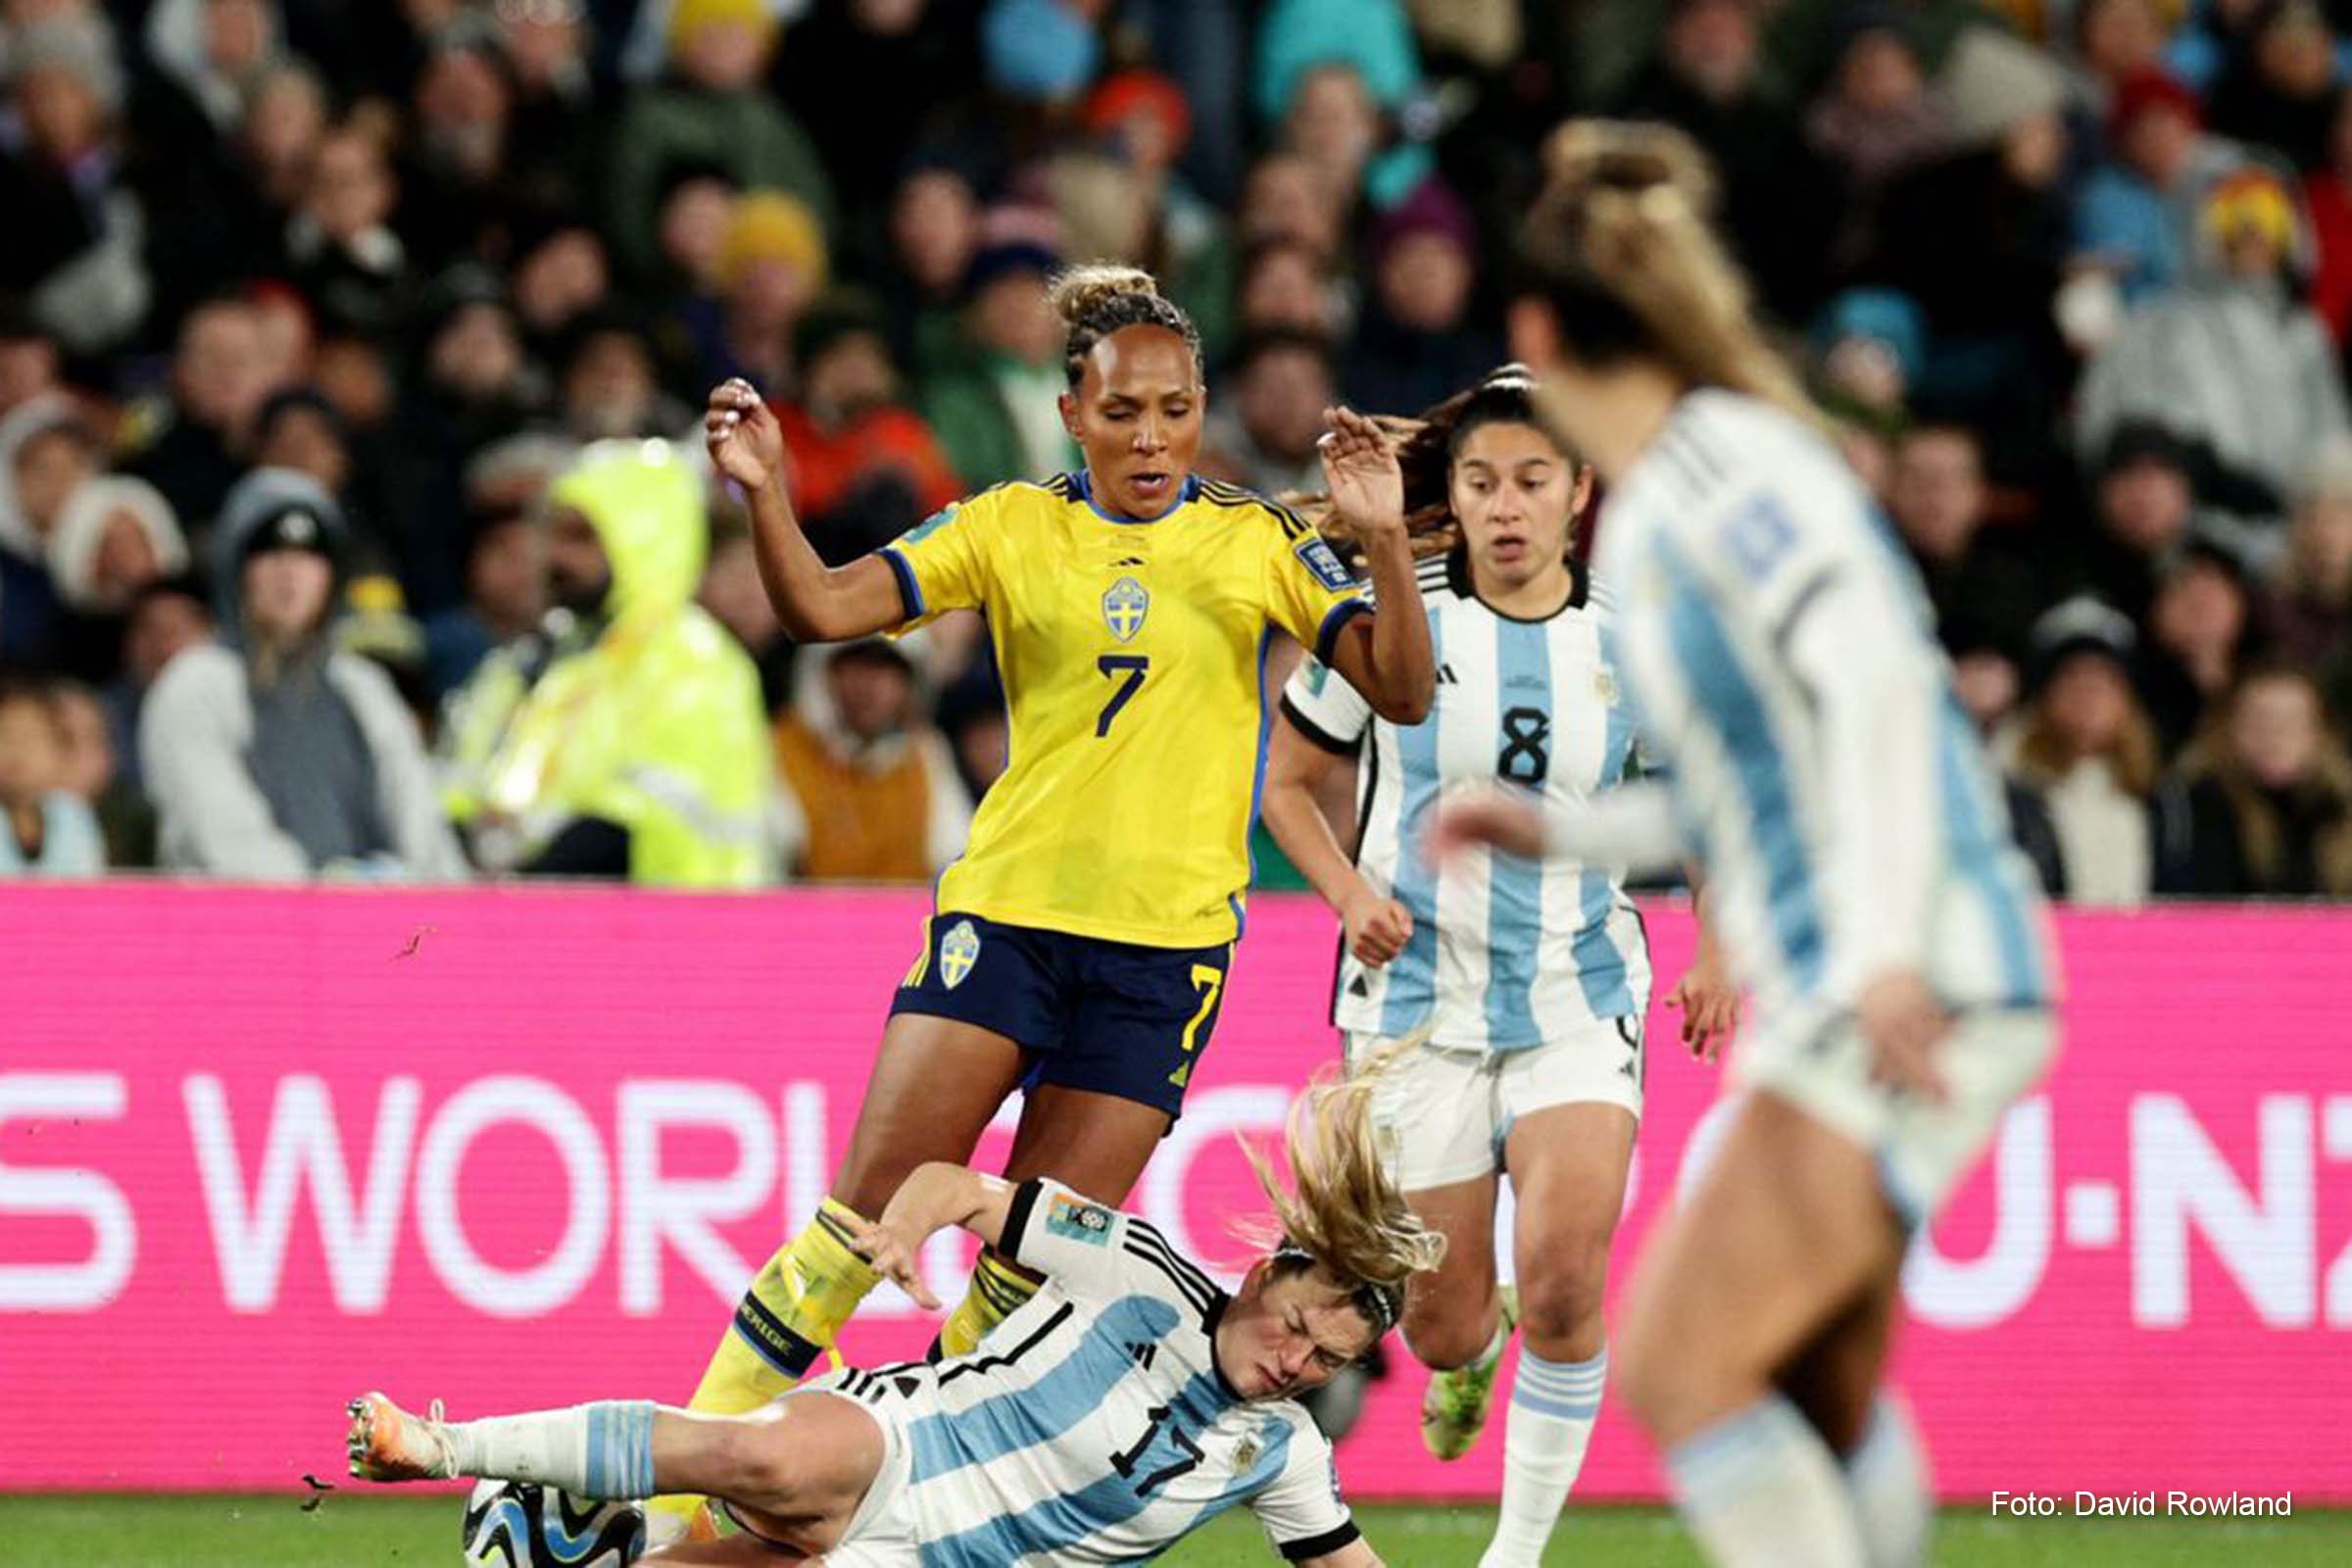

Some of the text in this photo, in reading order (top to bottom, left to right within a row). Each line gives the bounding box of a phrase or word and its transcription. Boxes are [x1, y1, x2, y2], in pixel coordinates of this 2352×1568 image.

[1096, 654, 1150, 737] 7
[1498, 707, 1550, 785] 8
[1181, 963, 1222, 1052] 7
[1108, 1402, 1206, 1498] 17
